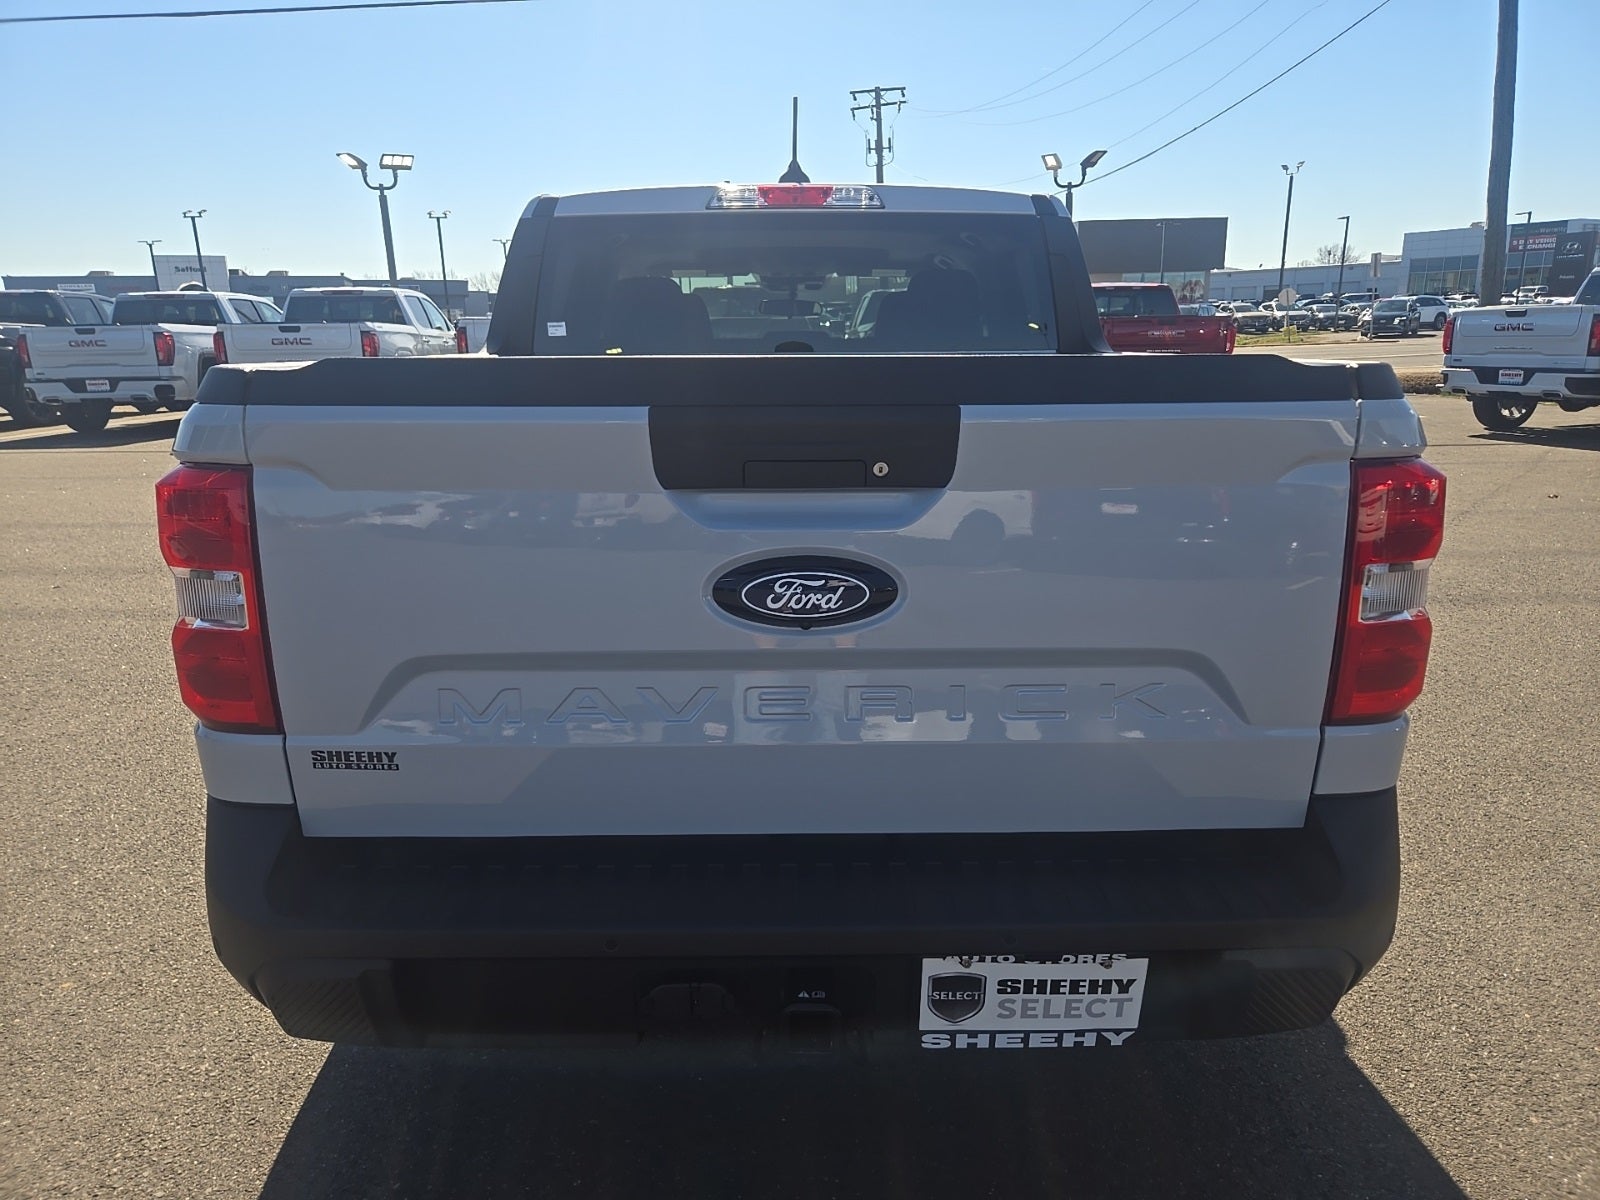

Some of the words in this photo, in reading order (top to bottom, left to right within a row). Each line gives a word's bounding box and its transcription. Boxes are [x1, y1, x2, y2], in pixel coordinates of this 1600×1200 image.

[1494, 322, 1535, 332] GMC
[68, 339, 107, 348] GMC
[271, 337, 312, 346] GMC
[766, 578, 845, 611] Ford
[436, 682, 1168, 725] MAVERICK
[310, 750, 398, 763] SHEEHY
[996, 978, 1138, 996] SHEEHY
[932, 990, 980, 1001] SELECT
[996, 997, 1134, 1020] SELECT
[920, 1030, 1136, 1049] SHEEHY
